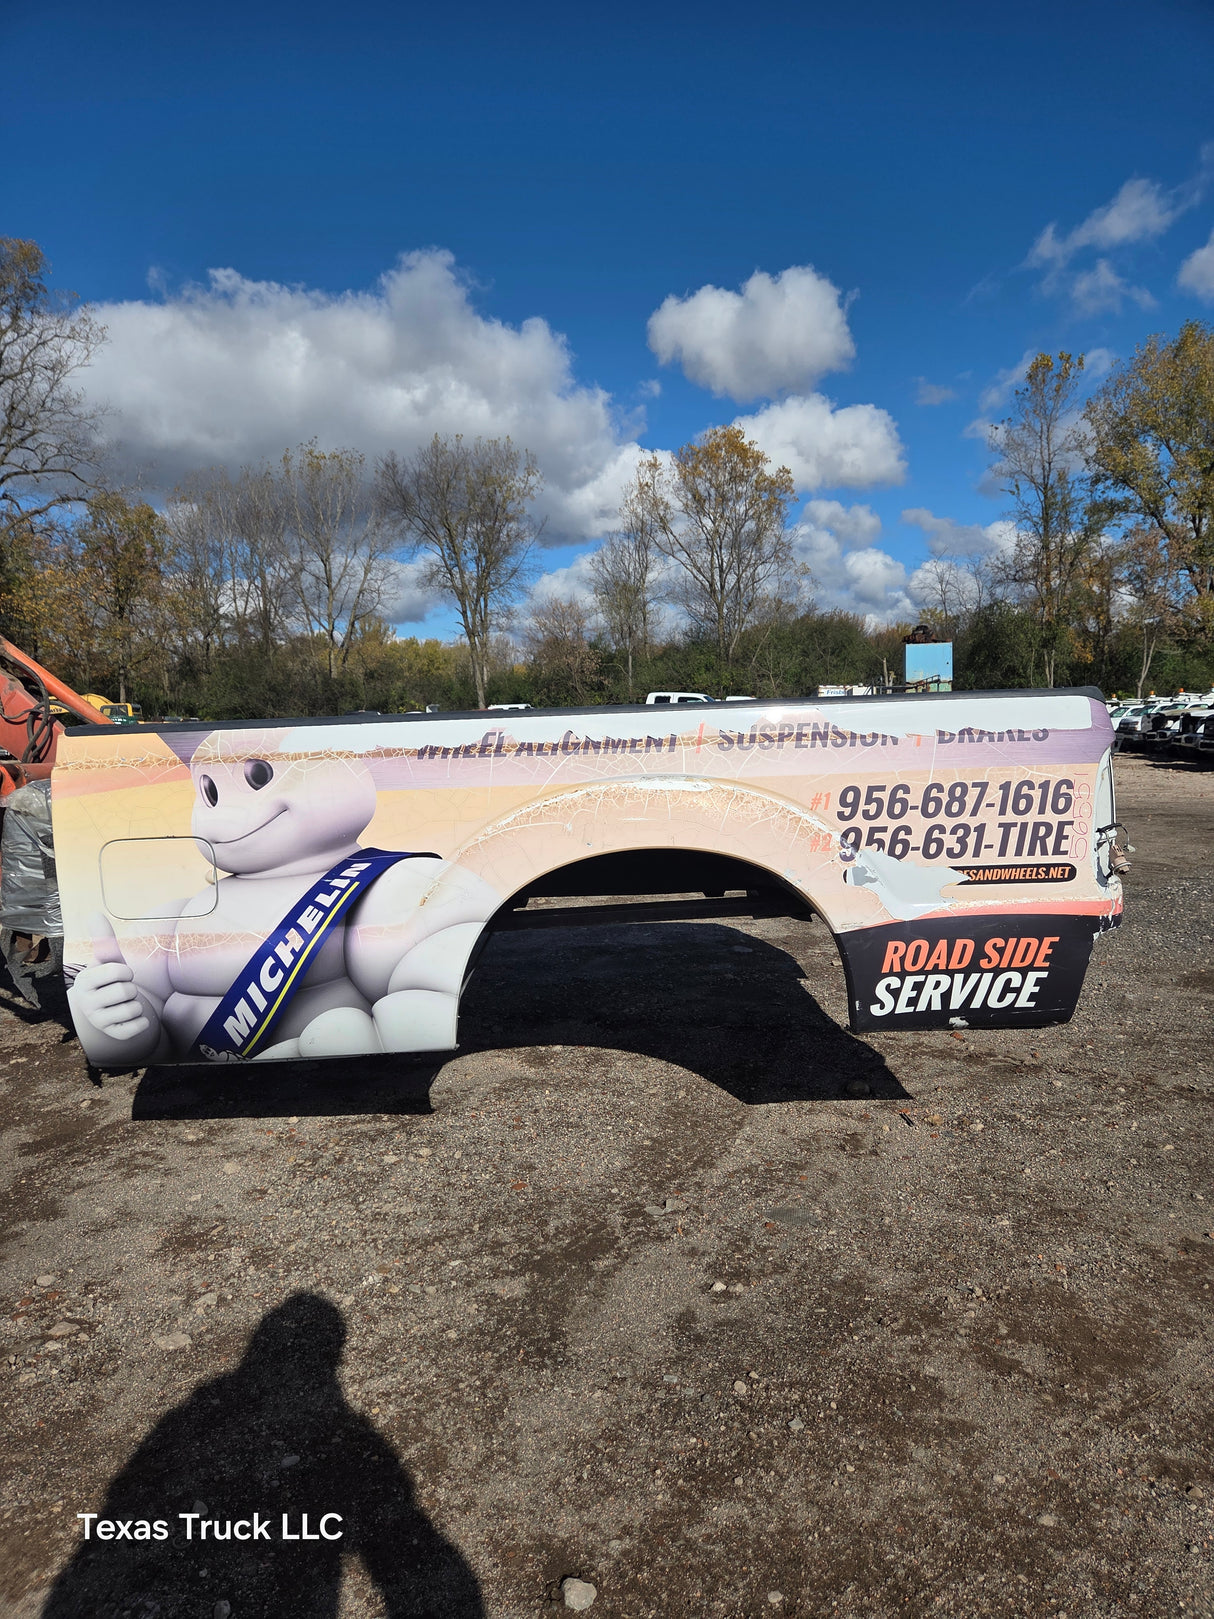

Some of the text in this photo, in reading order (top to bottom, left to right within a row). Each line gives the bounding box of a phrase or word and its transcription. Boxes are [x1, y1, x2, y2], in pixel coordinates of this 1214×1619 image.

[717, 721, 898, 751] SUSPENSION
[810, 778, 1074, 821] #1 956-687-1616
[809, 820, 1074, 862] #2 956-631-TIRE
[223, 862, 372, 1047] MICHELIN
[881, 937, 1060, 974] ROAD SIDE
[869, 971, 1049, 1017] SERVICE
